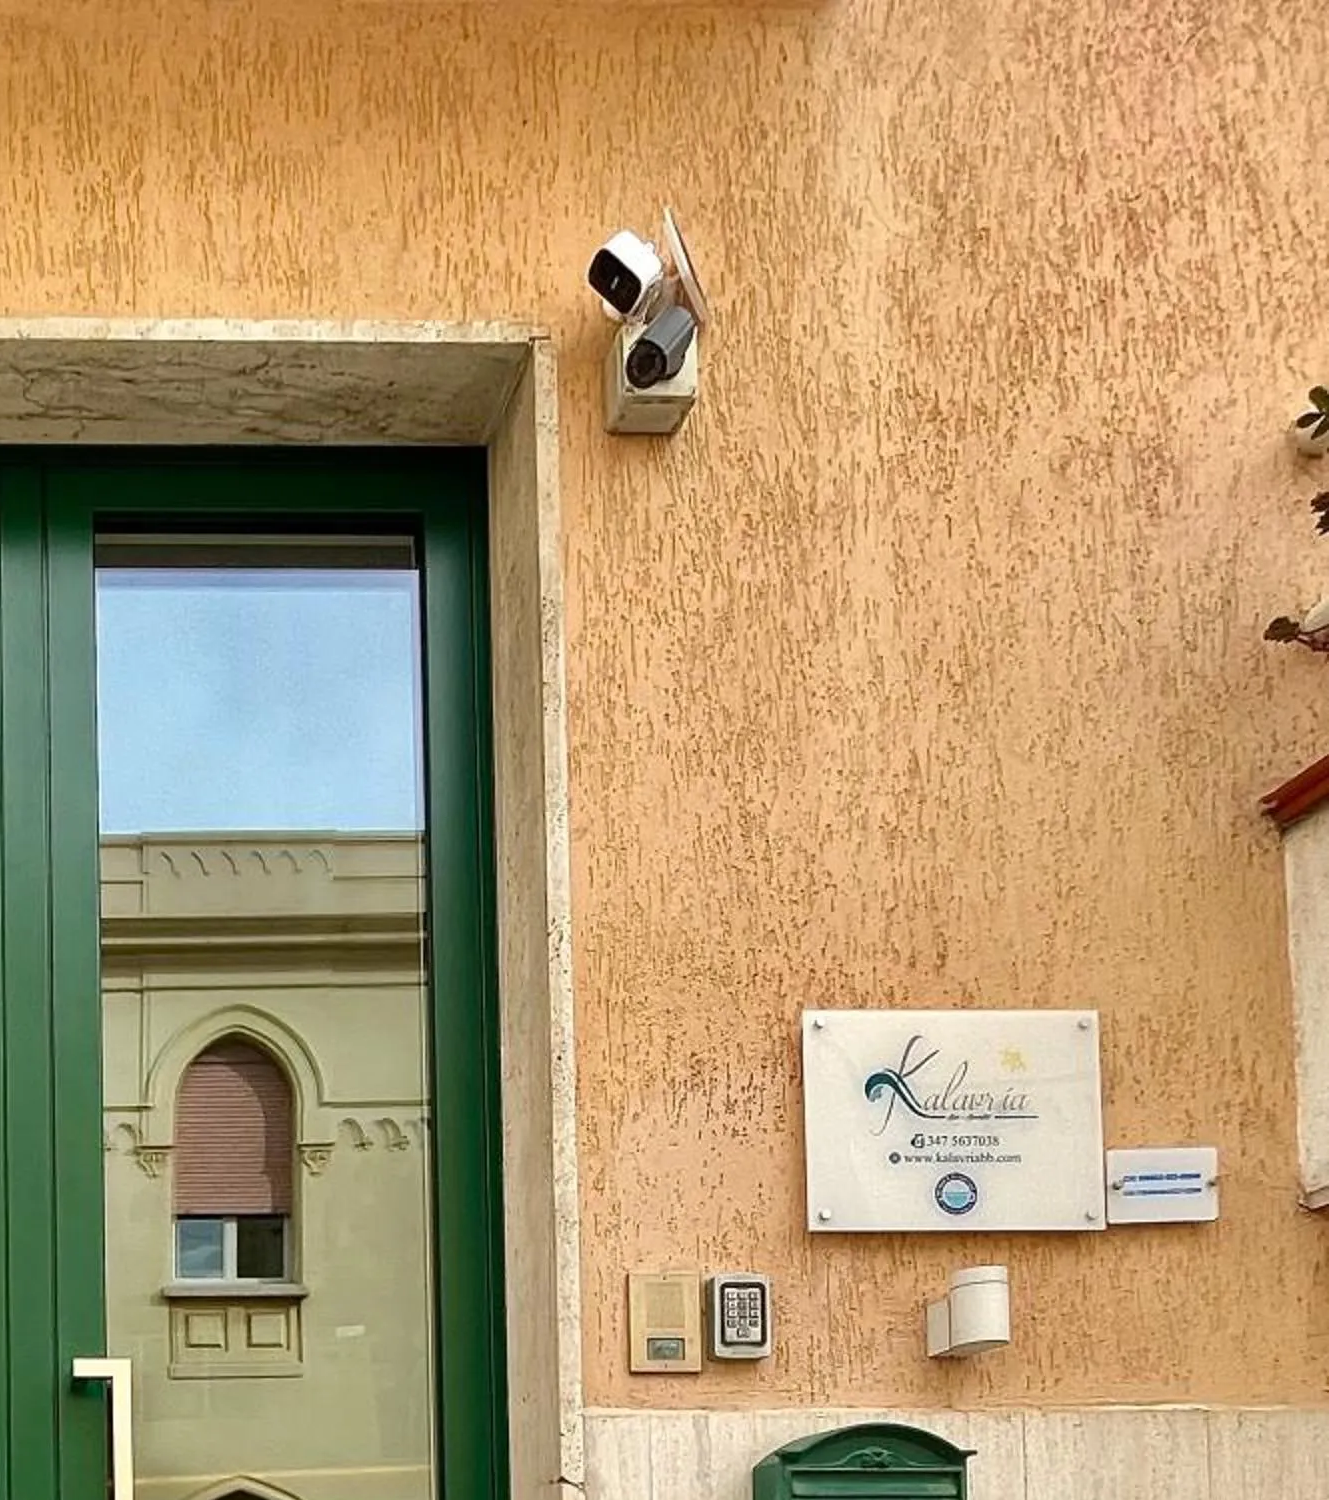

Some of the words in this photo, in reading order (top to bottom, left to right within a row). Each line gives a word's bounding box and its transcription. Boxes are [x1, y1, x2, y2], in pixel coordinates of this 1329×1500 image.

[865, 1035, 1031, 1137] Kalavria
[926, 1135, 948, 1147] 347
[951, 1135, 1000, 1147] 5637038
